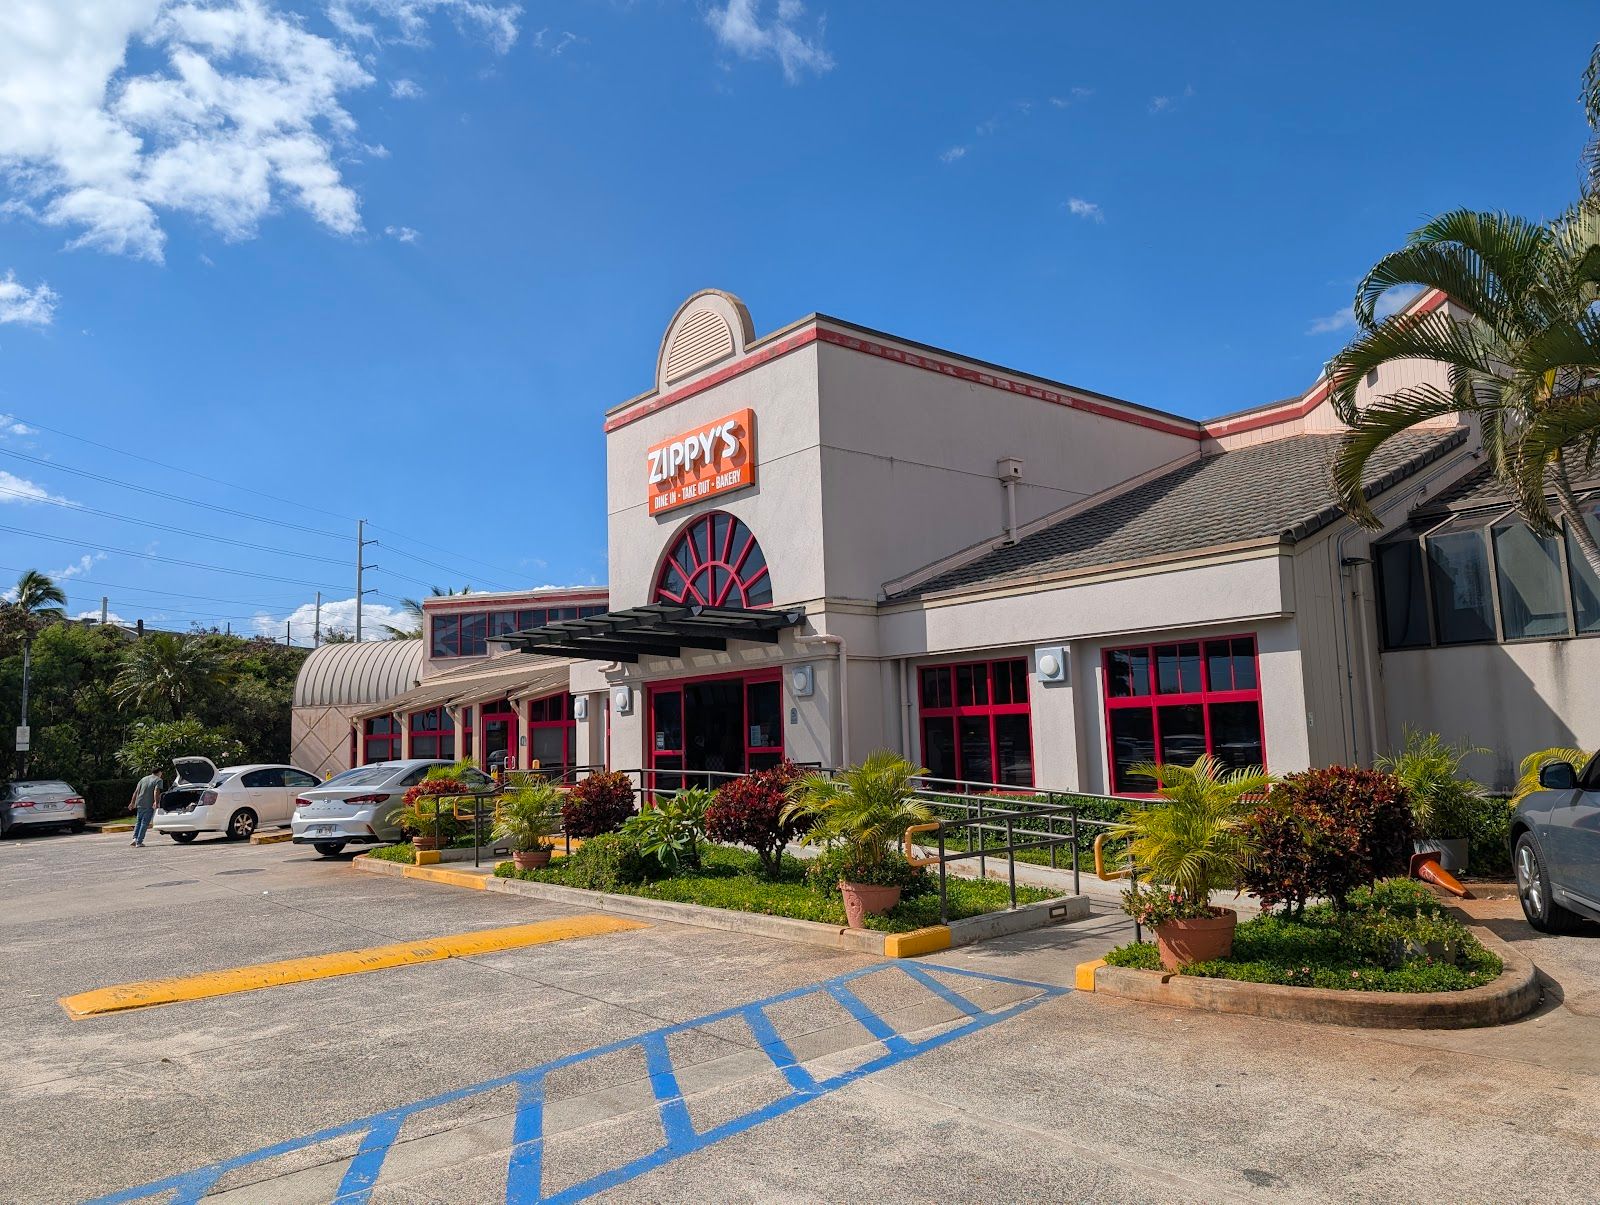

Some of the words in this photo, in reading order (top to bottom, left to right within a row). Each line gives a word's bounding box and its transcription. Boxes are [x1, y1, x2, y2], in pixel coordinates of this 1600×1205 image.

[648, 420, 737, 484] ZIPPY'S
[654, 494, 669, 509] DINE
[669, 491, 677, 505] IN
[682, 484, 697, 500] TAKE
[697, 480, 710, 495] OUT
[715, 469, 741, 489] BAKERY
